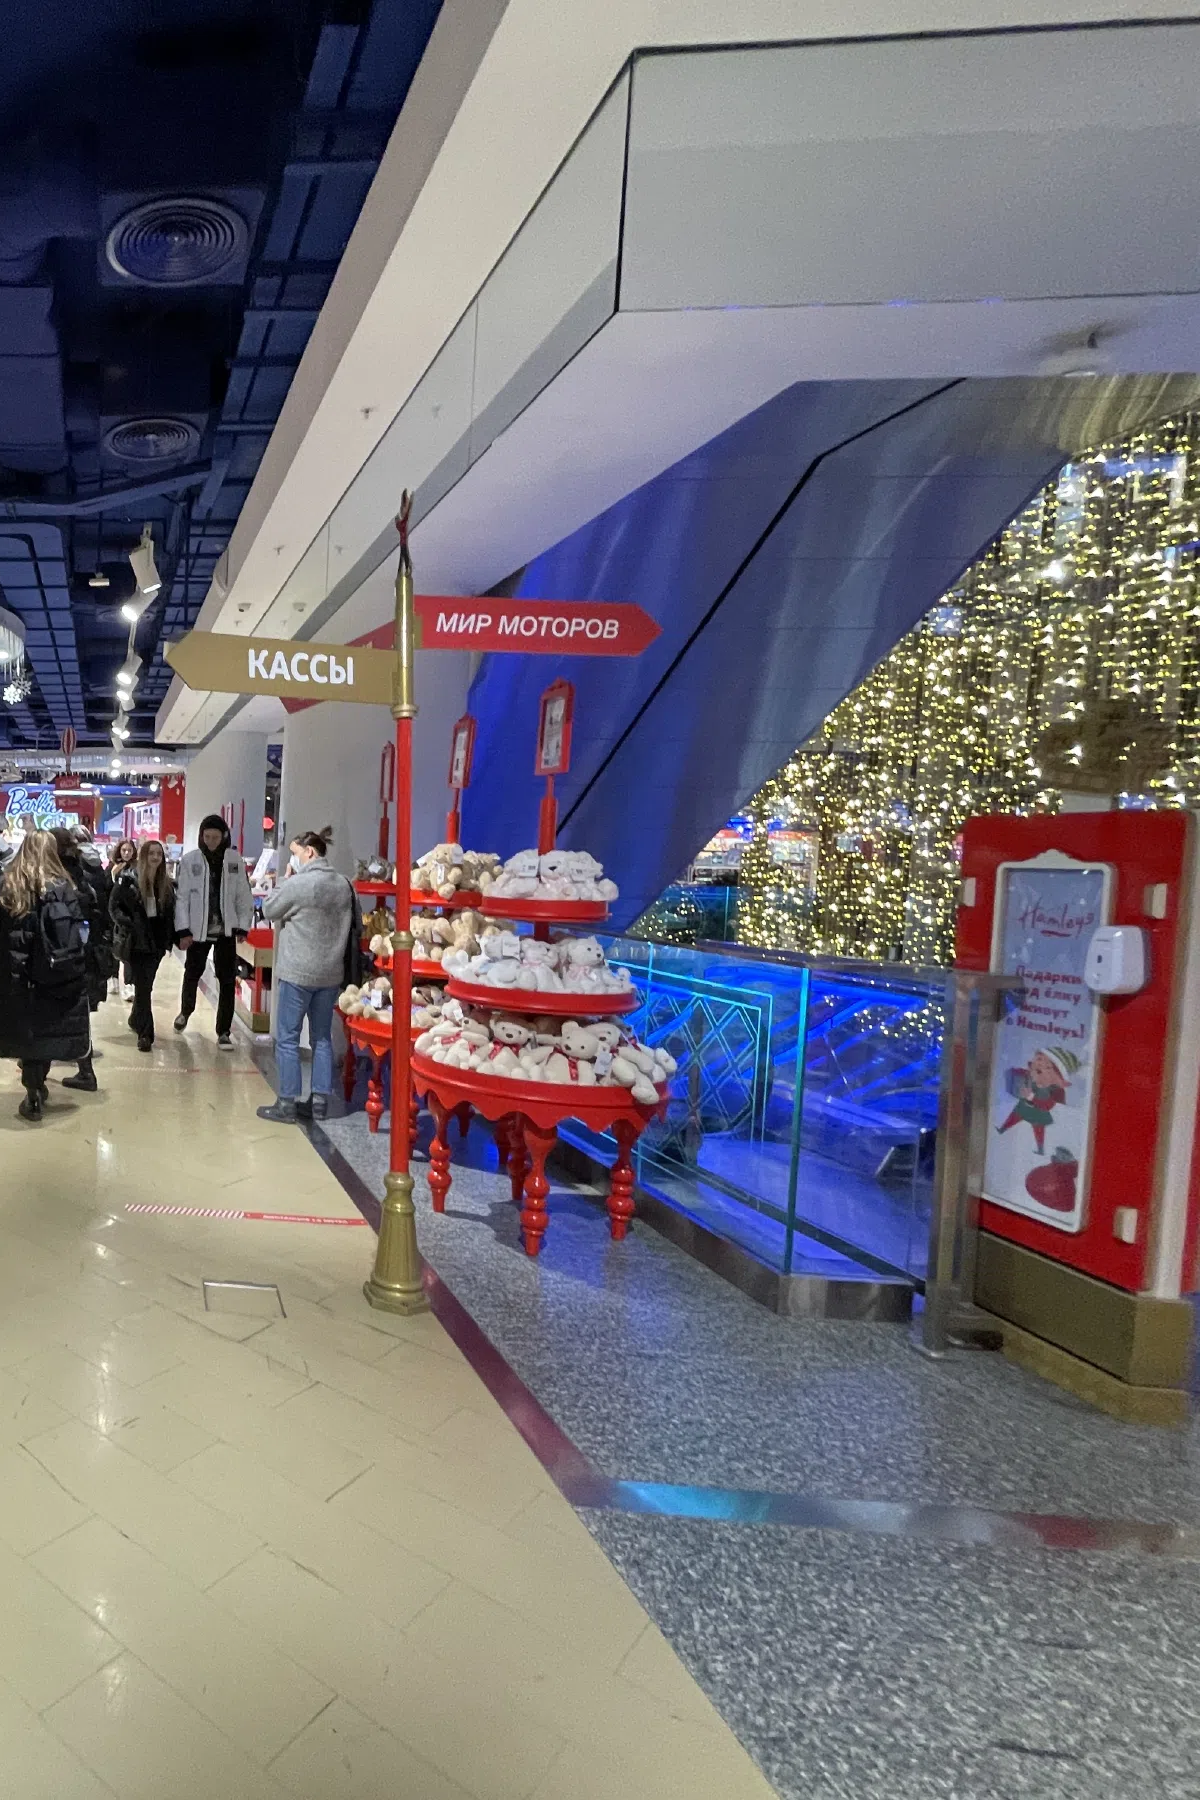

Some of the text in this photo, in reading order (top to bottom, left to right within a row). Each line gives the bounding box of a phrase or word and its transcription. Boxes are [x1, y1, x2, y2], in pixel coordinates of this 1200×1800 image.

[436, 612, 620, 639] МИР МОТОРОВ
[248, 648, 354, 685] КАССЫ
[7, 788, 62, 816] Barbi
[1018, 898, 1095, 939] Hamleys
[1016, 1015, 1085, 1040] Hamleys!
